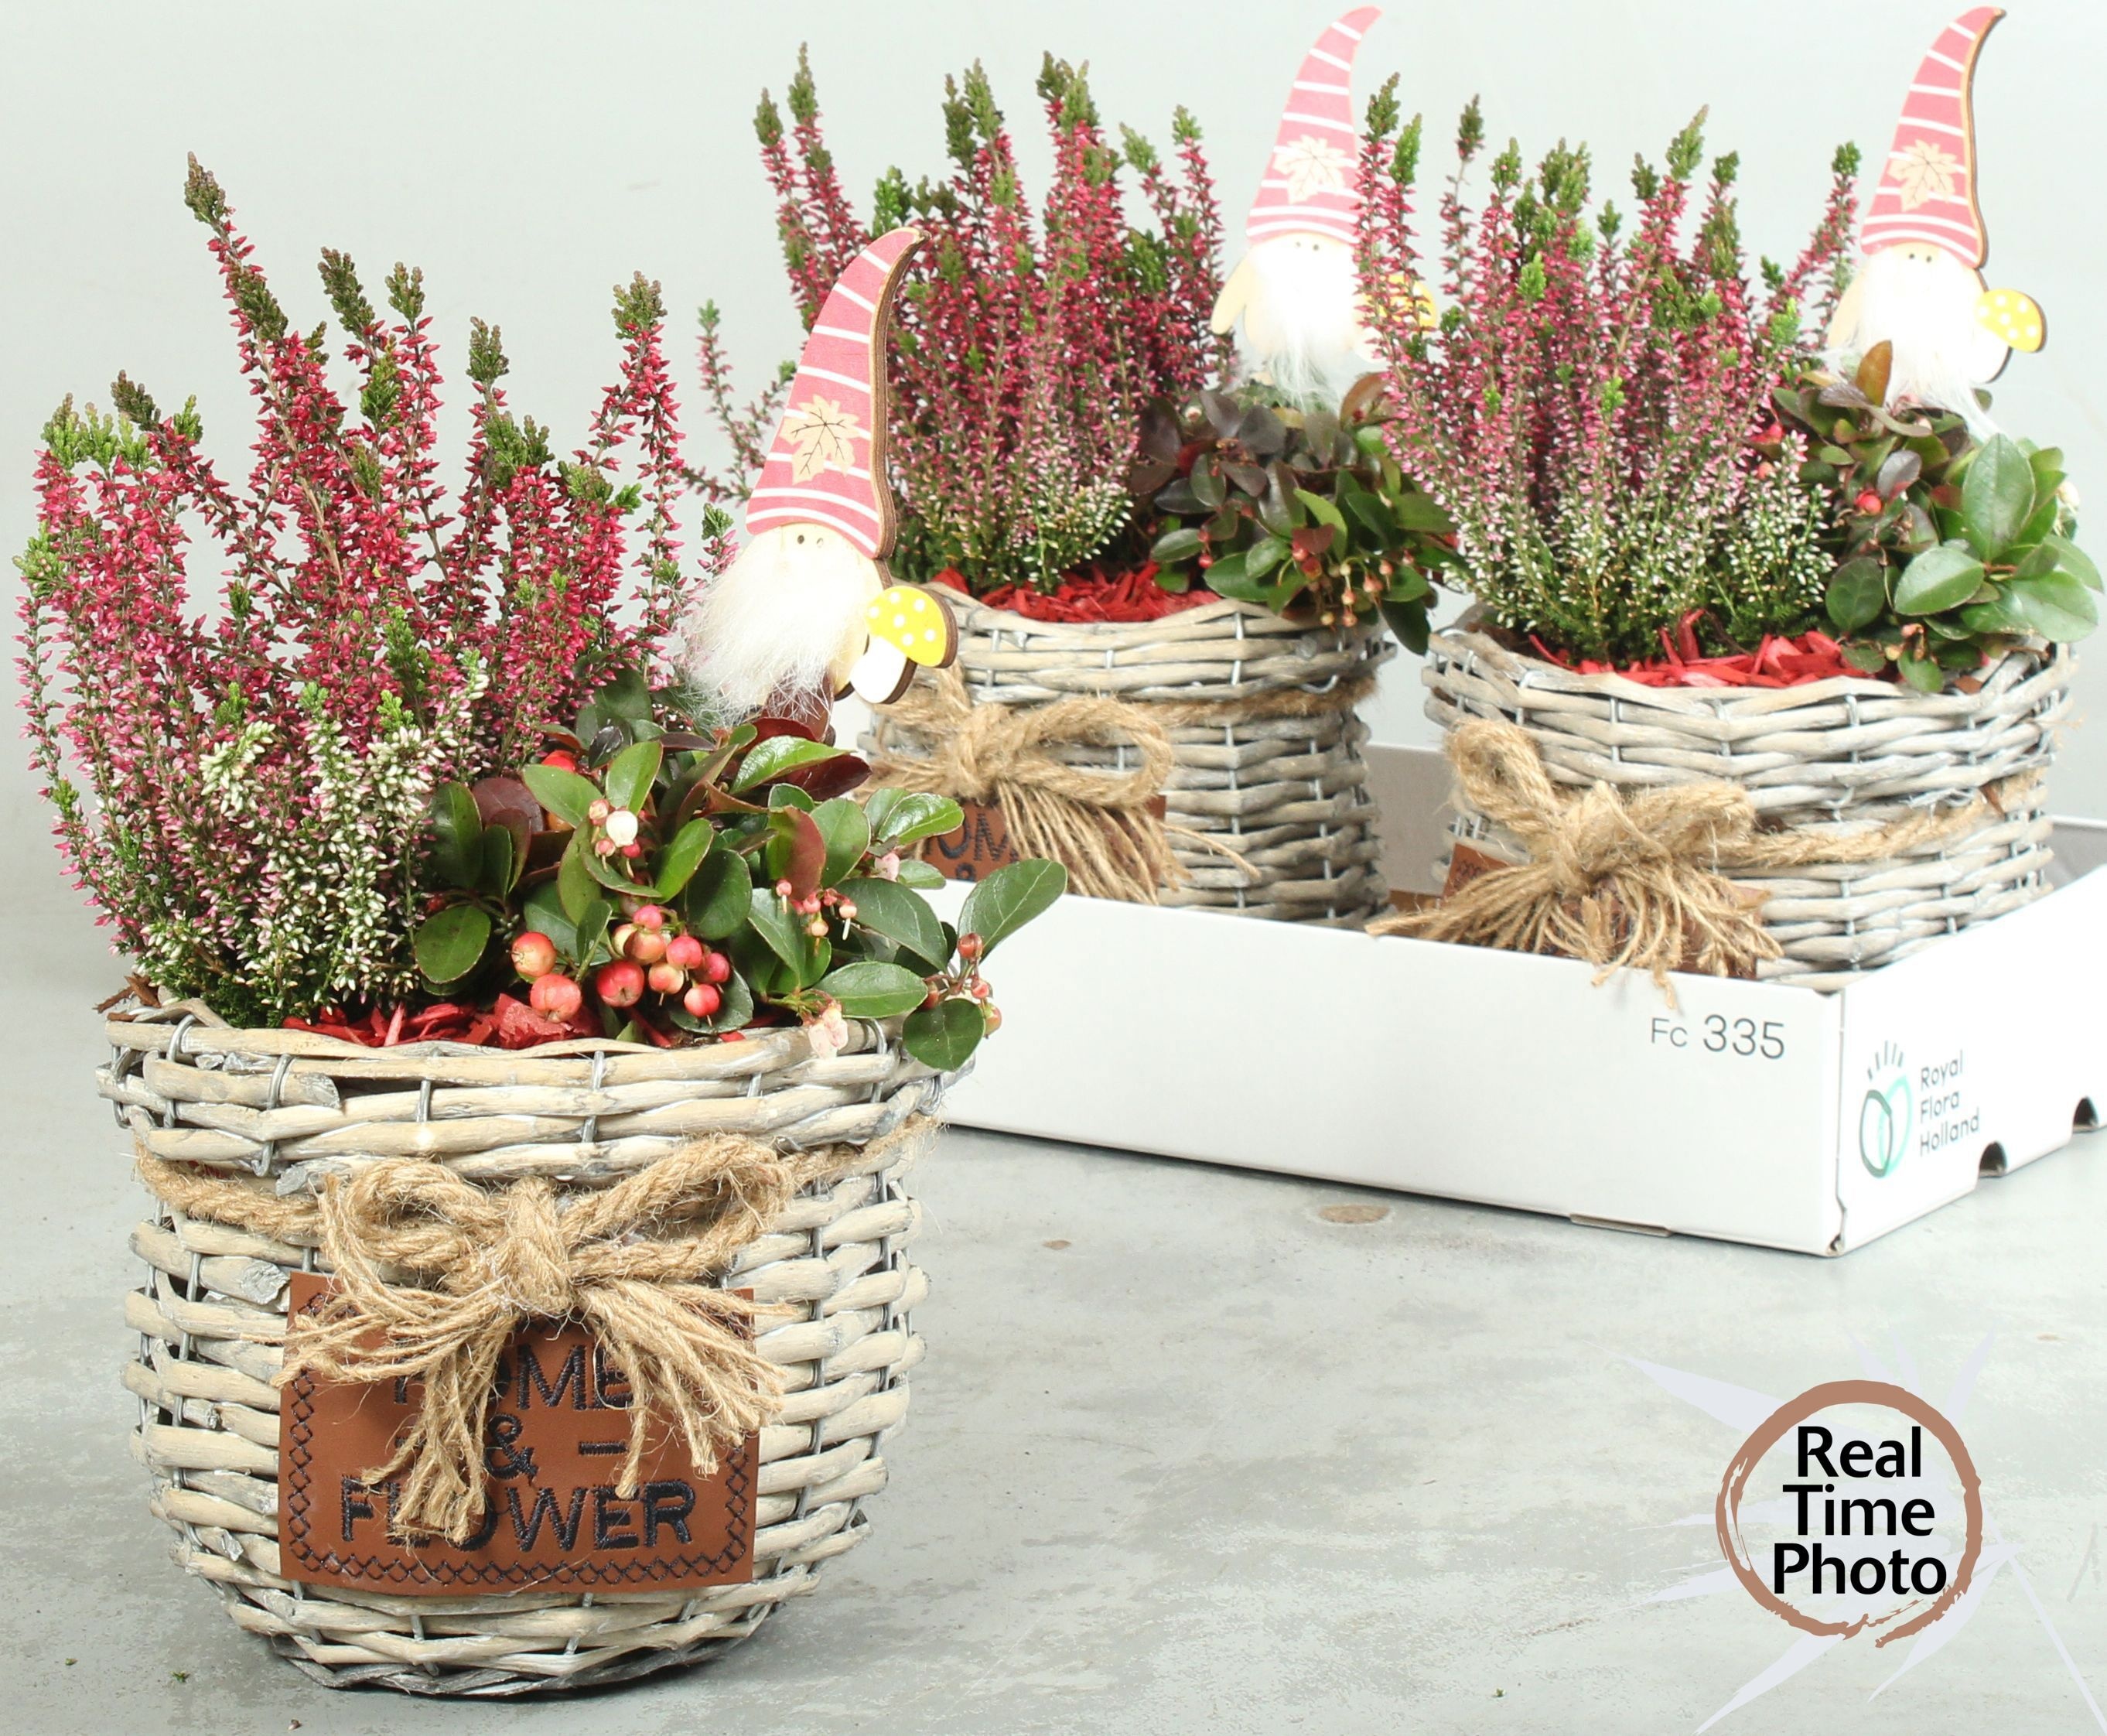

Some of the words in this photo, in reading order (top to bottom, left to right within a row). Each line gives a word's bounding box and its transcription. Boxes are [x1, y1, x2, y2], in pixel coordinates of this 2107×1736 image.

[1651, 1017, 1688, 1047] Fc
[1703, 1014, 1784, 1059] 335
[1921, 1049, 1963, 1091] Royal
[1921, 1091, 1959, 1123] Flora
[1920, 1106, 1979, 1157] Holland
[394, 1338, 636, 1410] ME
[483, 1413, 539, 1480] &
